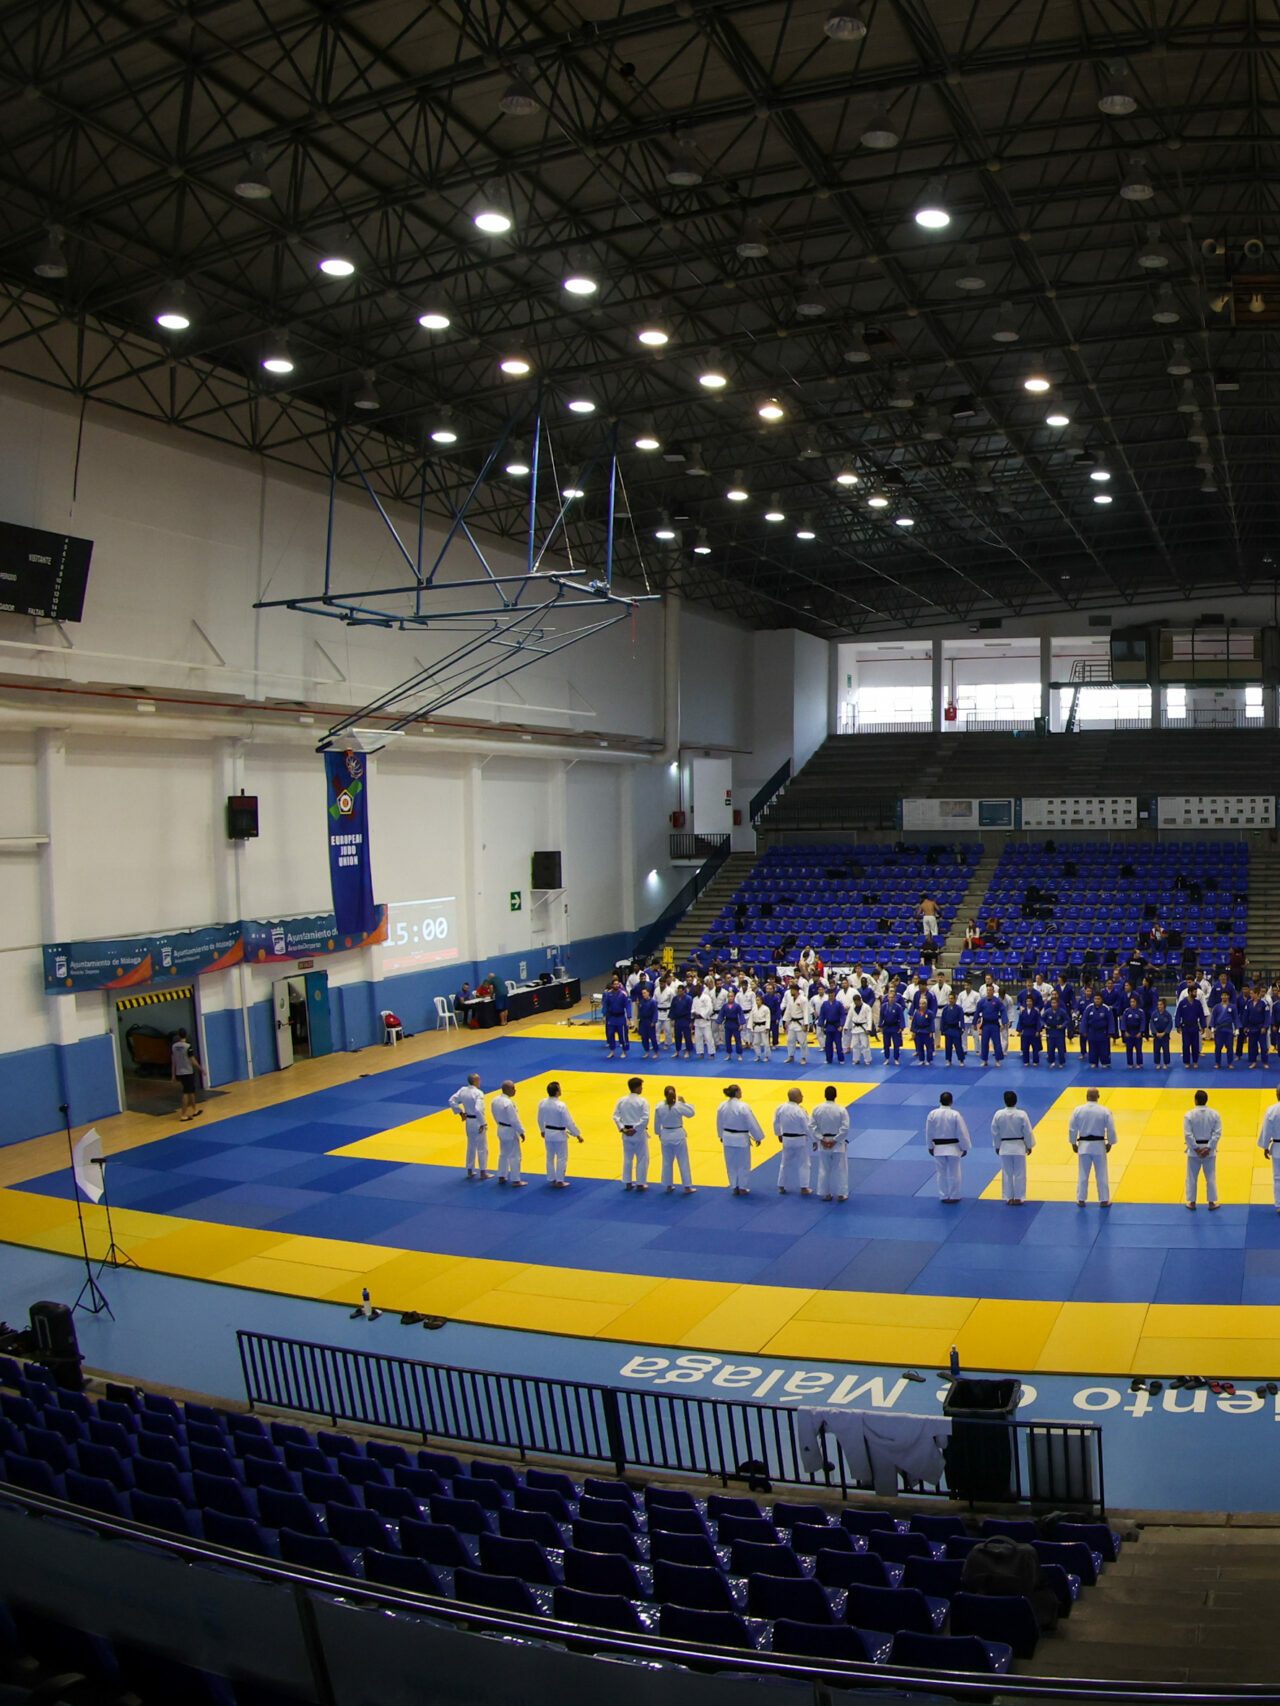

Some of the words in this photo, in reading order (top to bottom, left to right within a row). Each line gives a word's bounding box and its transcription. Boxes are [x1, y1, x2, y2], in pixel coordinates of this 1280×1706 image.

[340, 845, 356, 856] JUDO
[339, 856, 358, 867] UNION
[287, 929, 331, 943] Ayuntamiento
[382, 917, 448, 947] 15:00
[174, 945, 208, 957] Ayuntamiento
[70, 958, 110, 969] Ayuntamiento
[112, 957, 119, 966] de
[619, 1355, 909, 1408] Málaga
